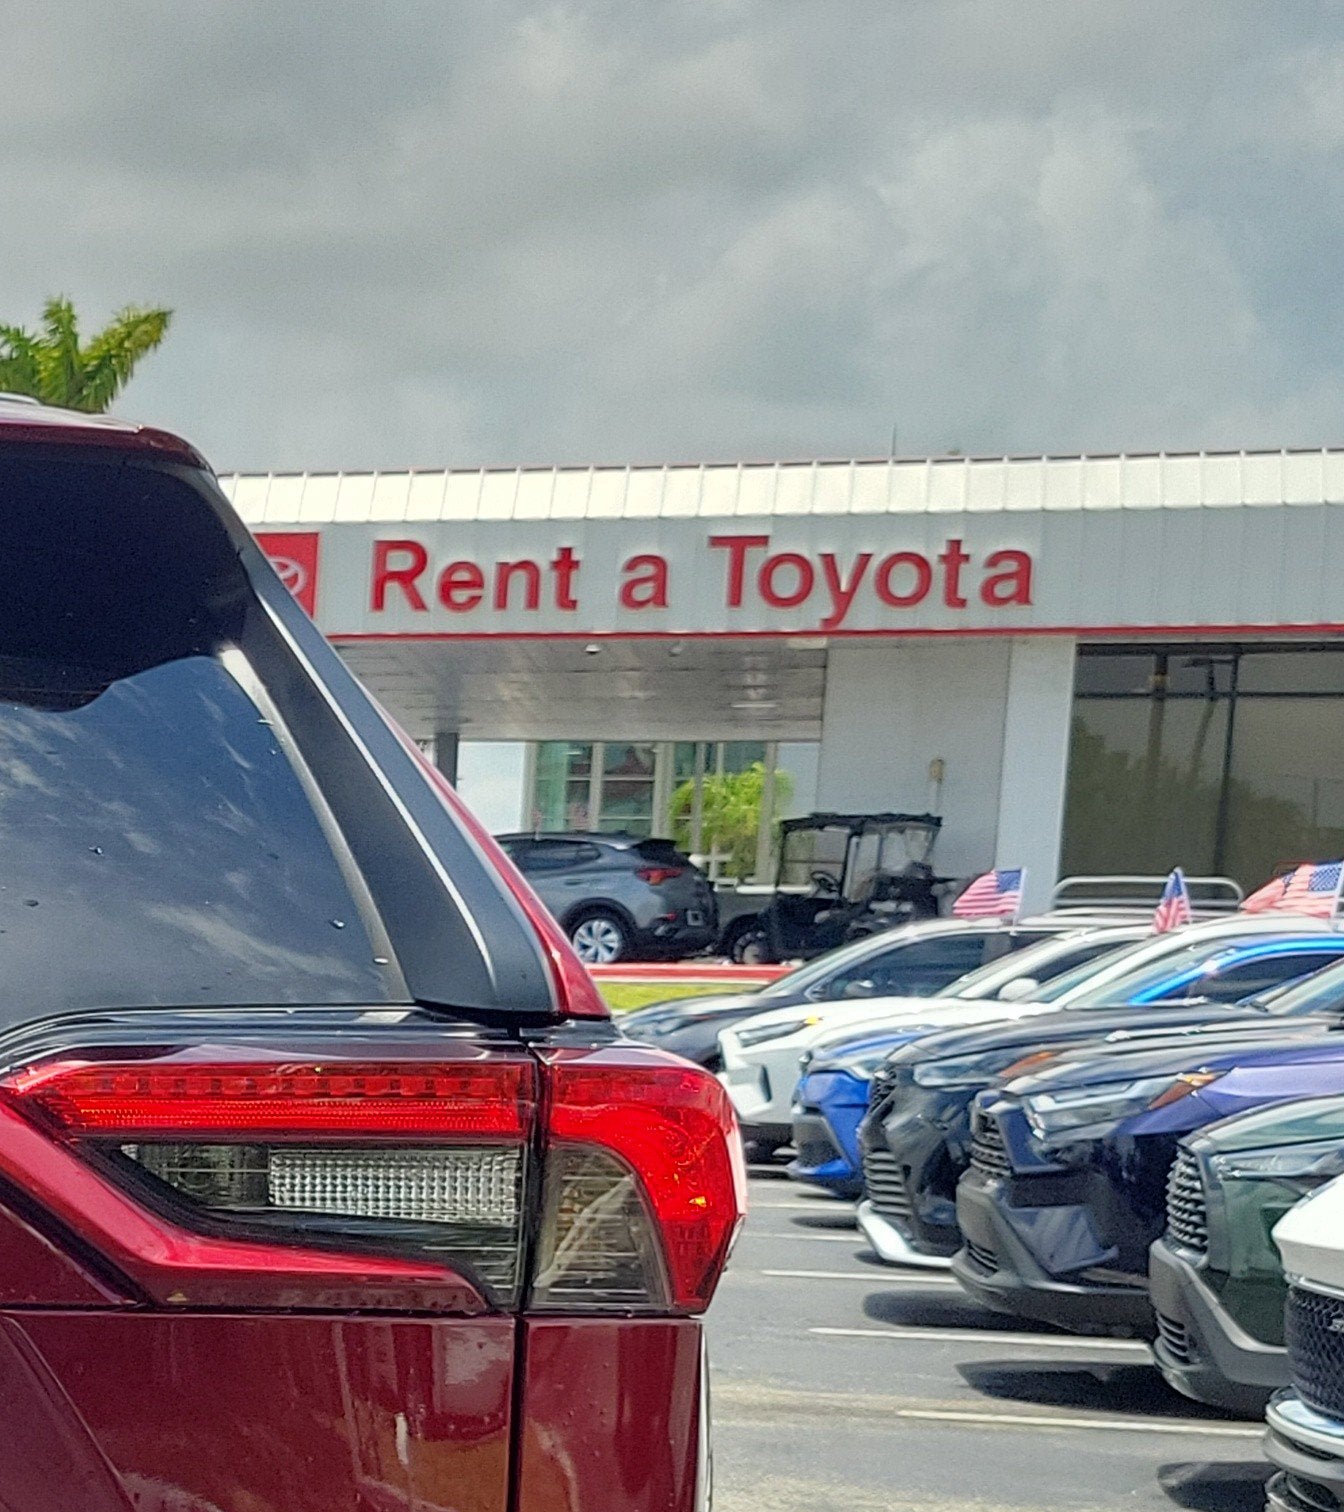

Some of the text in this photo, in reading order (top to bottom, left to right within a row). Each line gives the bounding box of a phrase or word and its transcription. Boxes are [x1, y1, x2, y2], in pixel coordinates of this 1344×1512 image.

[370, 534, 1034, 630] Rent a Toyota
